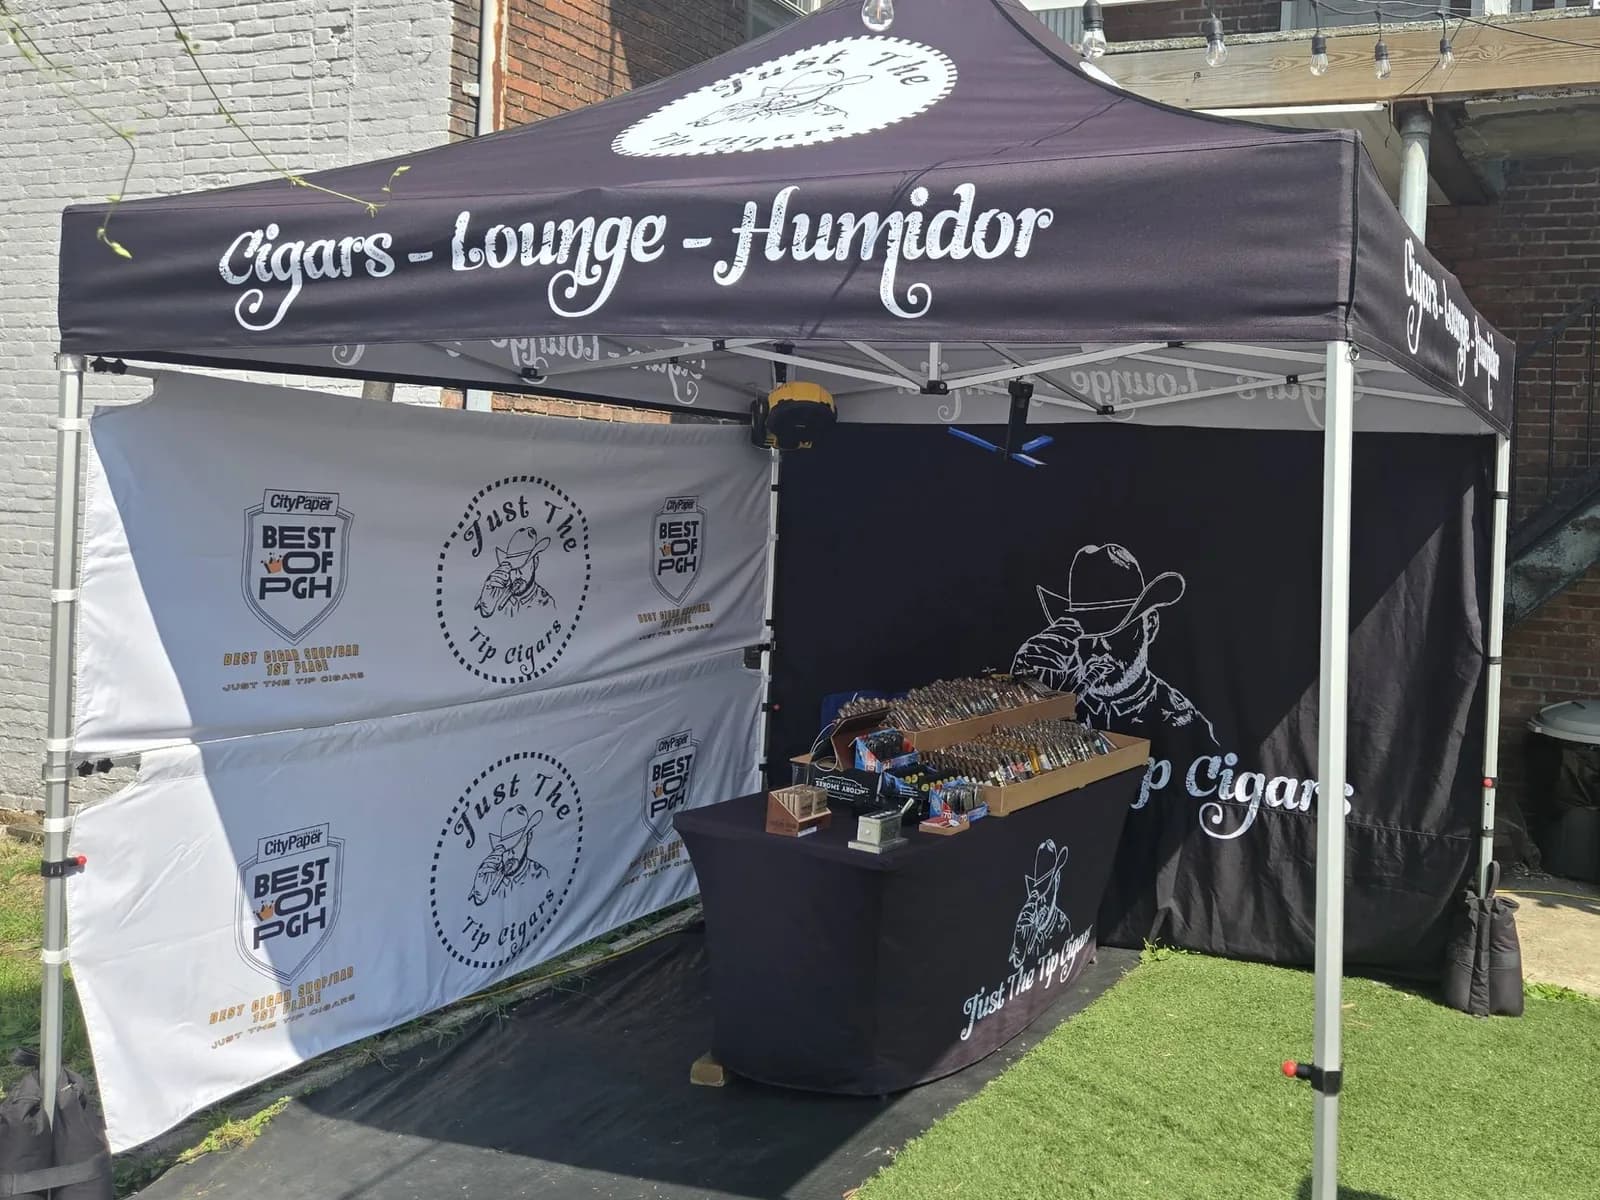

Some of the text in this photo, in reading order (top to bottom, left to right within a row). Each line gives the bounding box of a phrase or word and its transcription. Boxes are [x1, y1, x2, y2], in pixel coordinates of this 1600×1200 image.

[711, 48, 931, 98] Just The
[699, 123, 846, 152] Cigars
[218, 223, 396, 332] Cigars
[451, 211, 667, 318] Lounge
[712, 182, 1054, 319] Humidor
[1404, 237, 1438, 355] Cigars
[270, 494, 333, 513] CityPaper
[262, 525, 336, 549] BEST
[463, 495, 577, 557] Just The
[659, 520, 699, 539] BEST
[670, 538, 698, 556] OF
[282, 551, 334, 574] OF
[657, 556, 697, 576] PGH
[259, 576, 333, 600] PGH
[223, 651, 258, 666] BEST
[263, 648, 299, 663] CIGAR
[469, 619, 562, 676] Tip Cigars
[266, 662, 289, 676] 1ST
[222, 681, 259, 691] JUST
[263, 679, 290, 688] THE
[296, 676, 317, 685] TIP
[652, 754, 693, 782] BEST
[662, 771, 689, 795] OF
[453, 772, 571, 848] Just The
[650, 788, 686, 818] PGH
[264, 831, 323, 856] CityPaper
[254, 857, 330, 898] BEST
[273, 882, 327, 916] OF
[253, 907, 326, 950] PGH
[462, 889, 555, 956] Tip Cigars
[960, 982, 1006, 1041] Just
[1007, 965, 1035, 1001] The
[1038, 948, 1060, 989] Tip
[209, 1003, 246, 1025] BEST
[211, 1032, 244, 1049] JUST
[248, 1022, 277, 1034] THE
